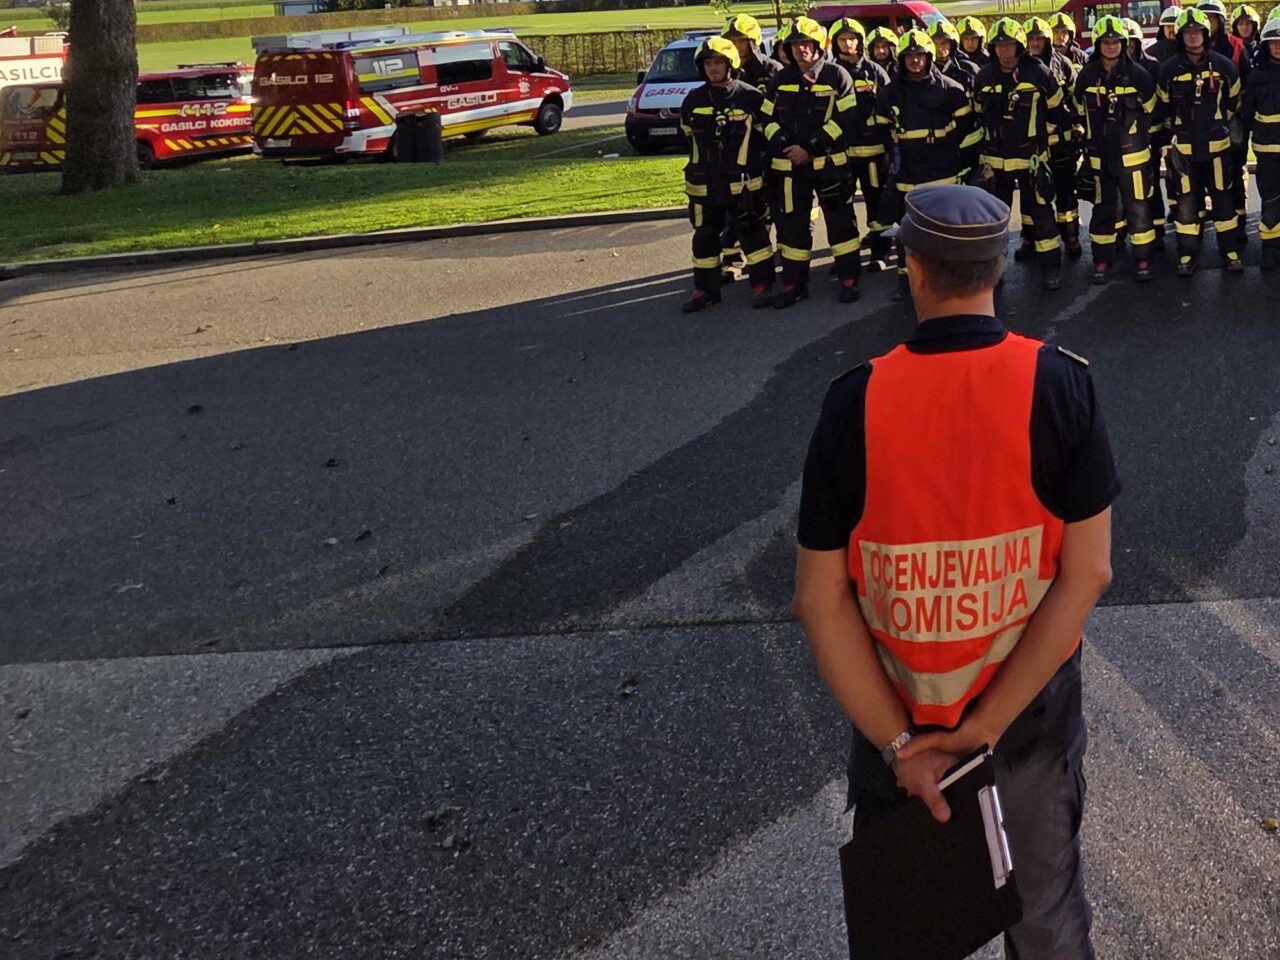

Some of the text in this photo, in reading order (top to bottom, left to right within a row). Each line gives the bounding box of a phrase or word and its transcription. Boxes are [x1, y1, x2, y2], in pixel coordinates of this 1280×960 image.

[372, 58, 403, 76] 112
[259, 73, 334, 87] GASILCI 112
[447, 92, 497, 110] GASILCI
[644, 87, 687, 98] GASIL
[190, 102, 228, 117] 112
[160, 117, 252, 133] GASILCI KOKRIC
[870, 536, 1032, 592] OCENJEVALNA
[872, 578, 1029, 635] KOMISIJA
